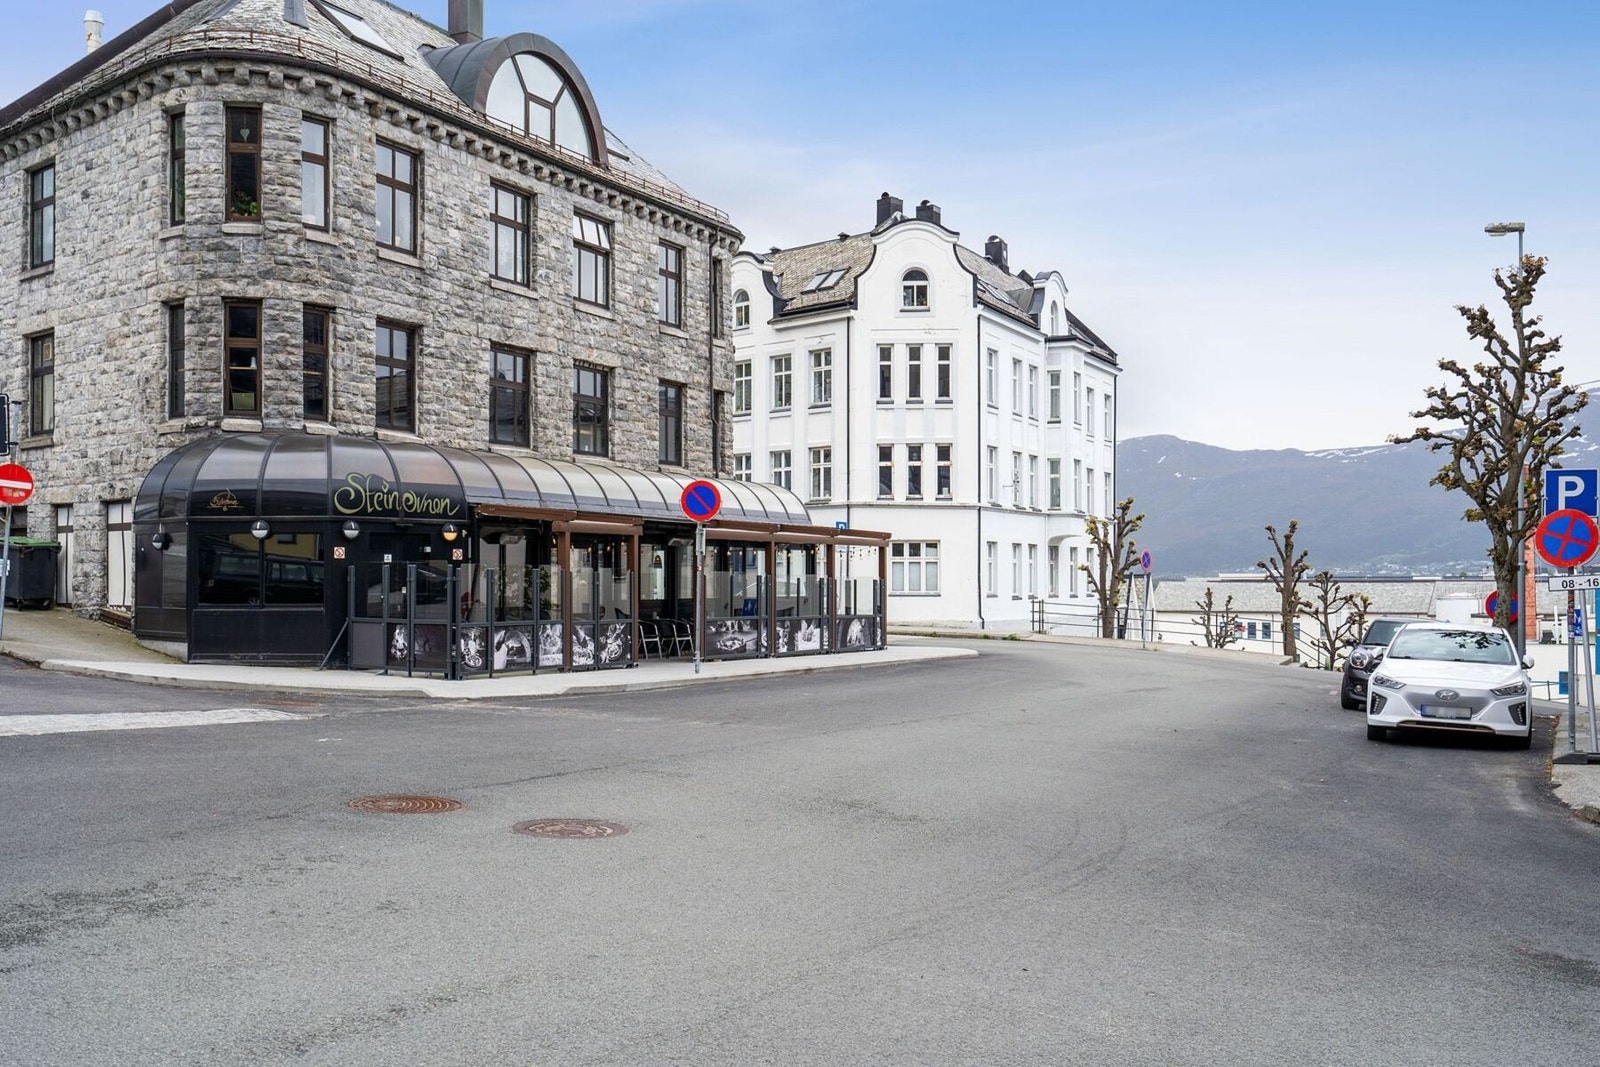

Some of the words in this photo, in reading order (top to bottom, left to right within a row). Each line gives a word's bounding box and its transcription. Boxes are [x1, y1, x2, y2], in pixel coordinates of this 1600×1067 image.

[1558, 475, 1585, 510] P
[1561, 579, 1575, 589] 08
[1587, 578, 1600, 587] 16
